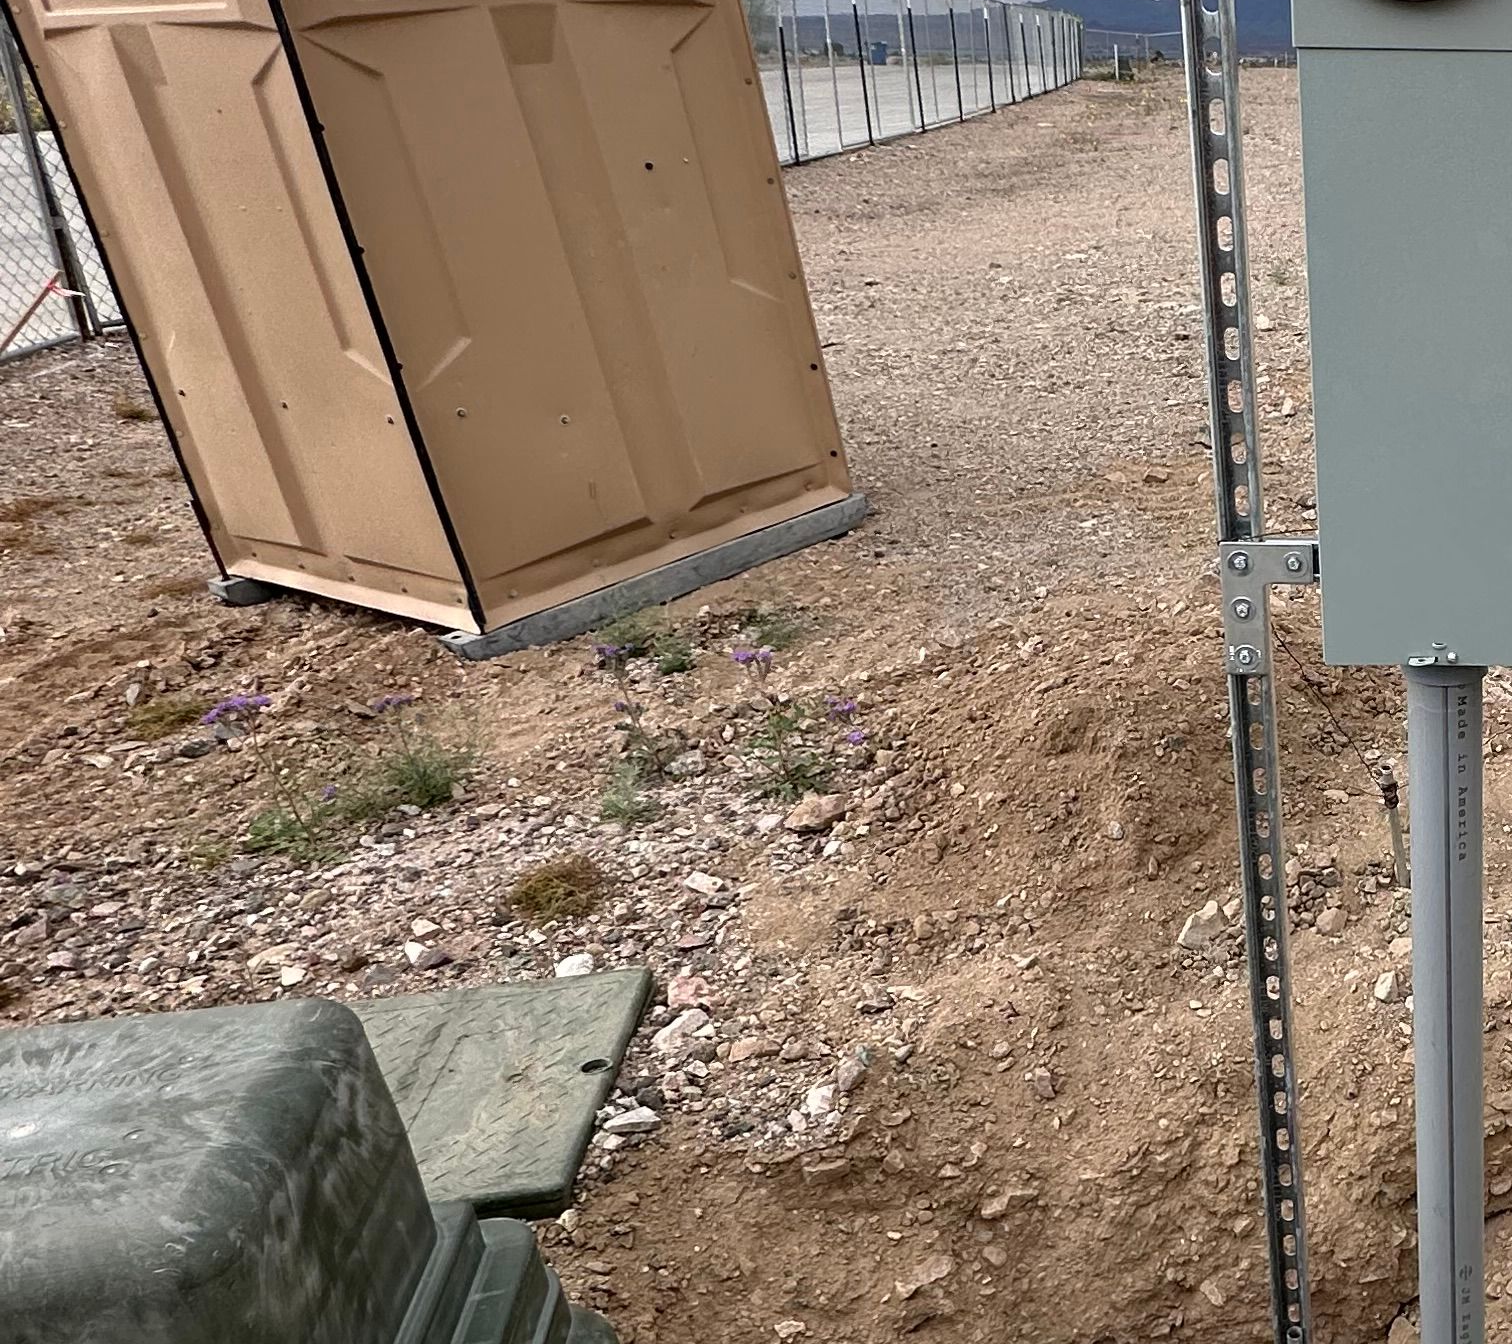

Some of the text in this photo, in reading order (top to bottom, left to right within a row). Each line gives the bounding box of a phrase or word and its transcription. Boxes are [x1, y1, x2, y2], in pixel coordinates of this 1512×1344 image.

[1457, 694, 1469, 741] Made
[1457, 753, 1468, 775] in
[1457, 785, 1469, 862] America
